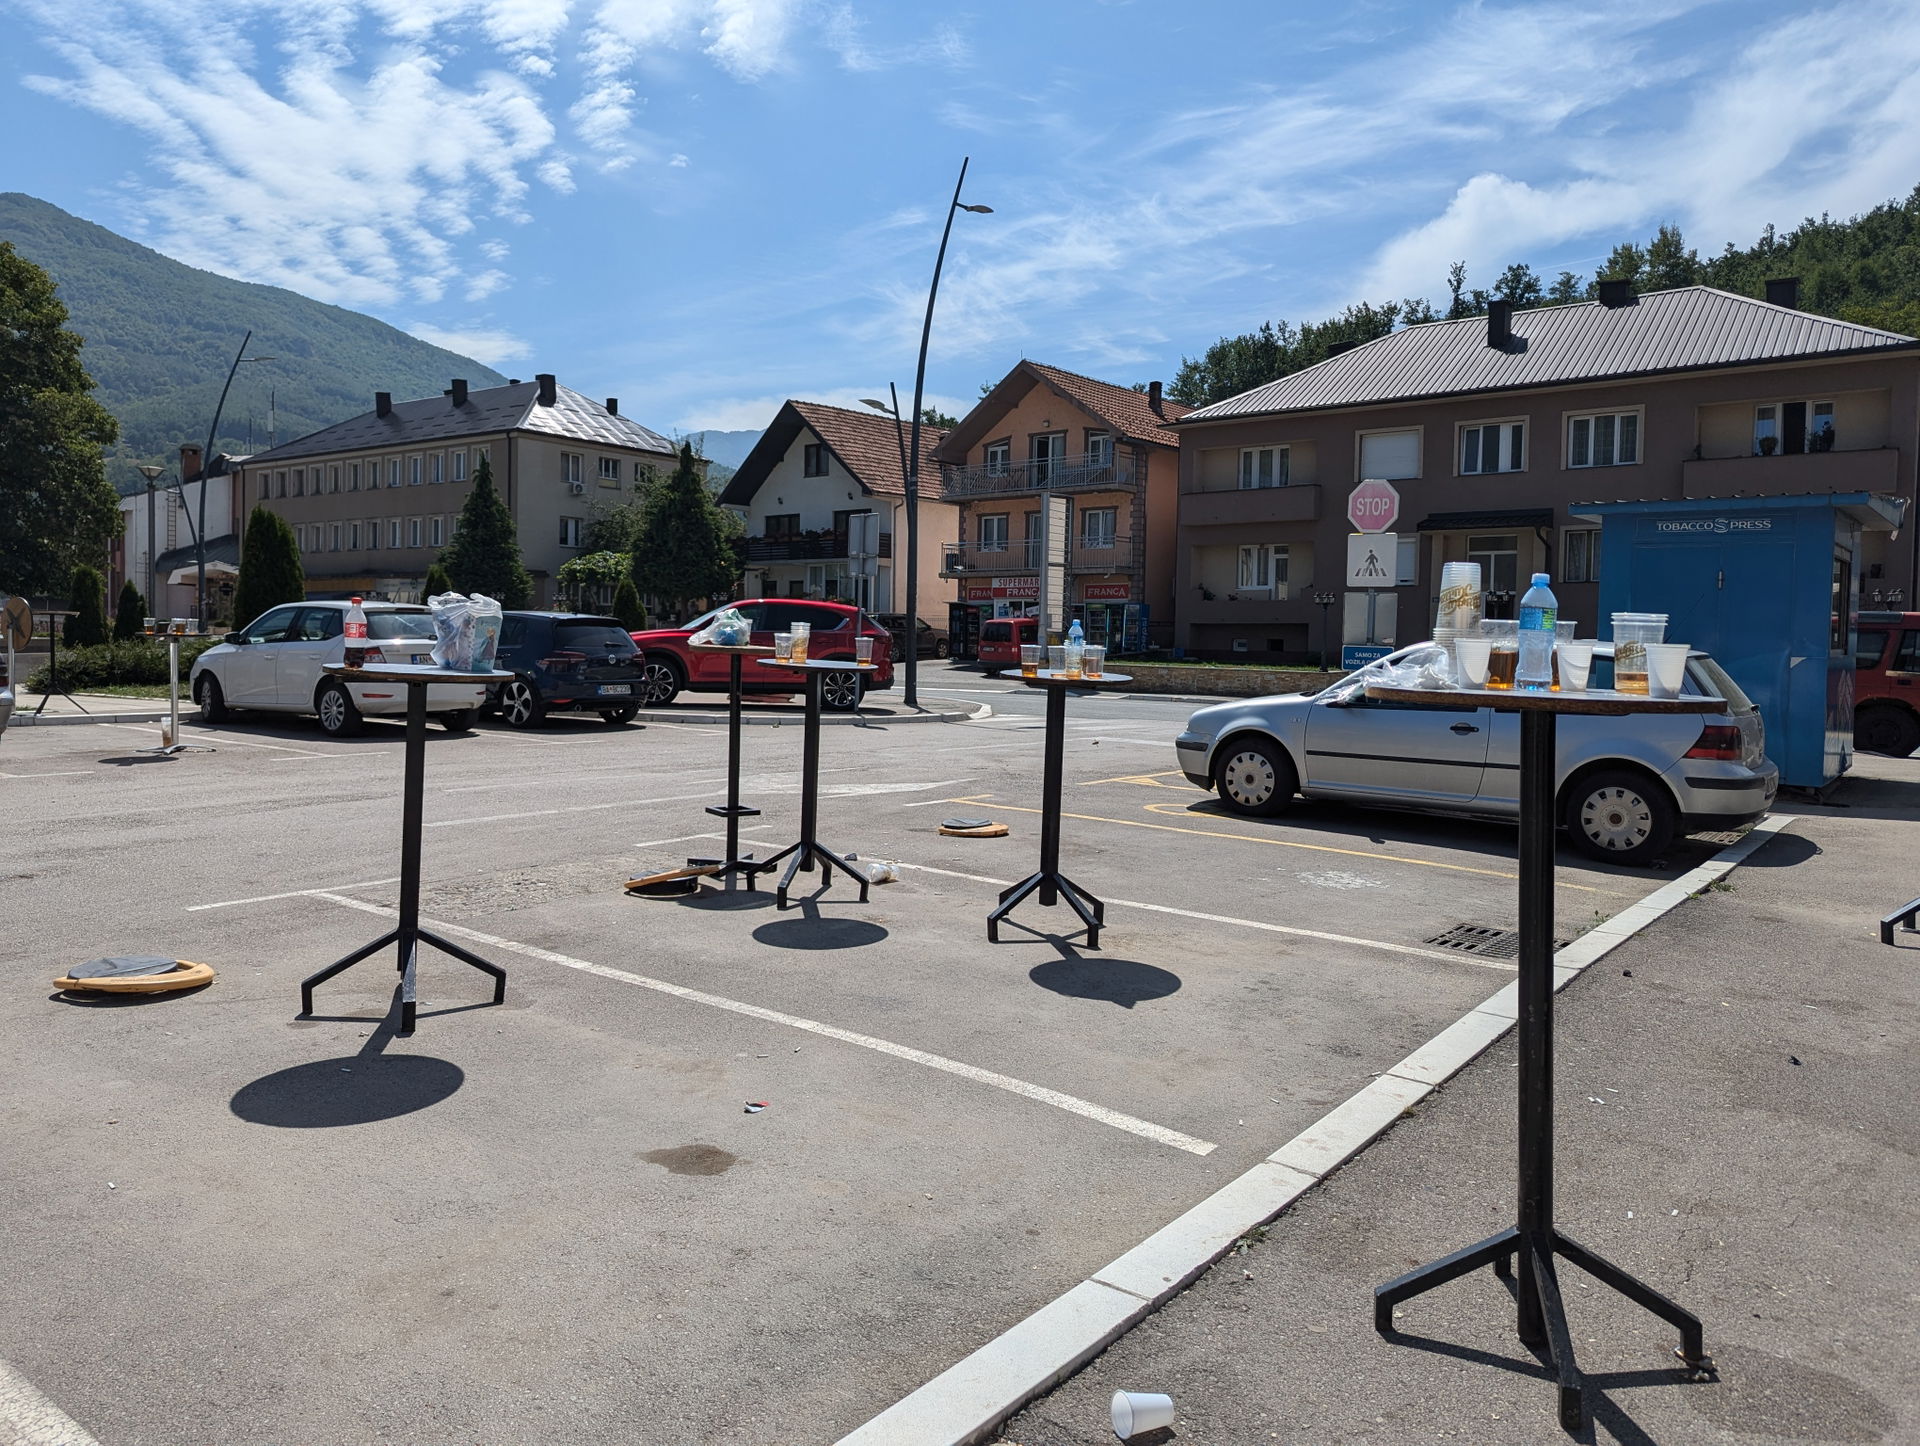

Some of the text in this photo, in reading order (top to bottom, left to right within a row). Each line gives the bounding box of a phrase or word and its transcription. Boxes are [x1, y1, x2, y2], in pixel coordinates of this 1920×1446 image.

[1356, 498, 1390, 516] STOP
[1657, 521, 1714, 531] TOBACCO
[1730, 519, 1772, 529] PRESS
[998, 577, 1039, 587] SUPERMAR
[970, 590, 993, 599] FRAN
